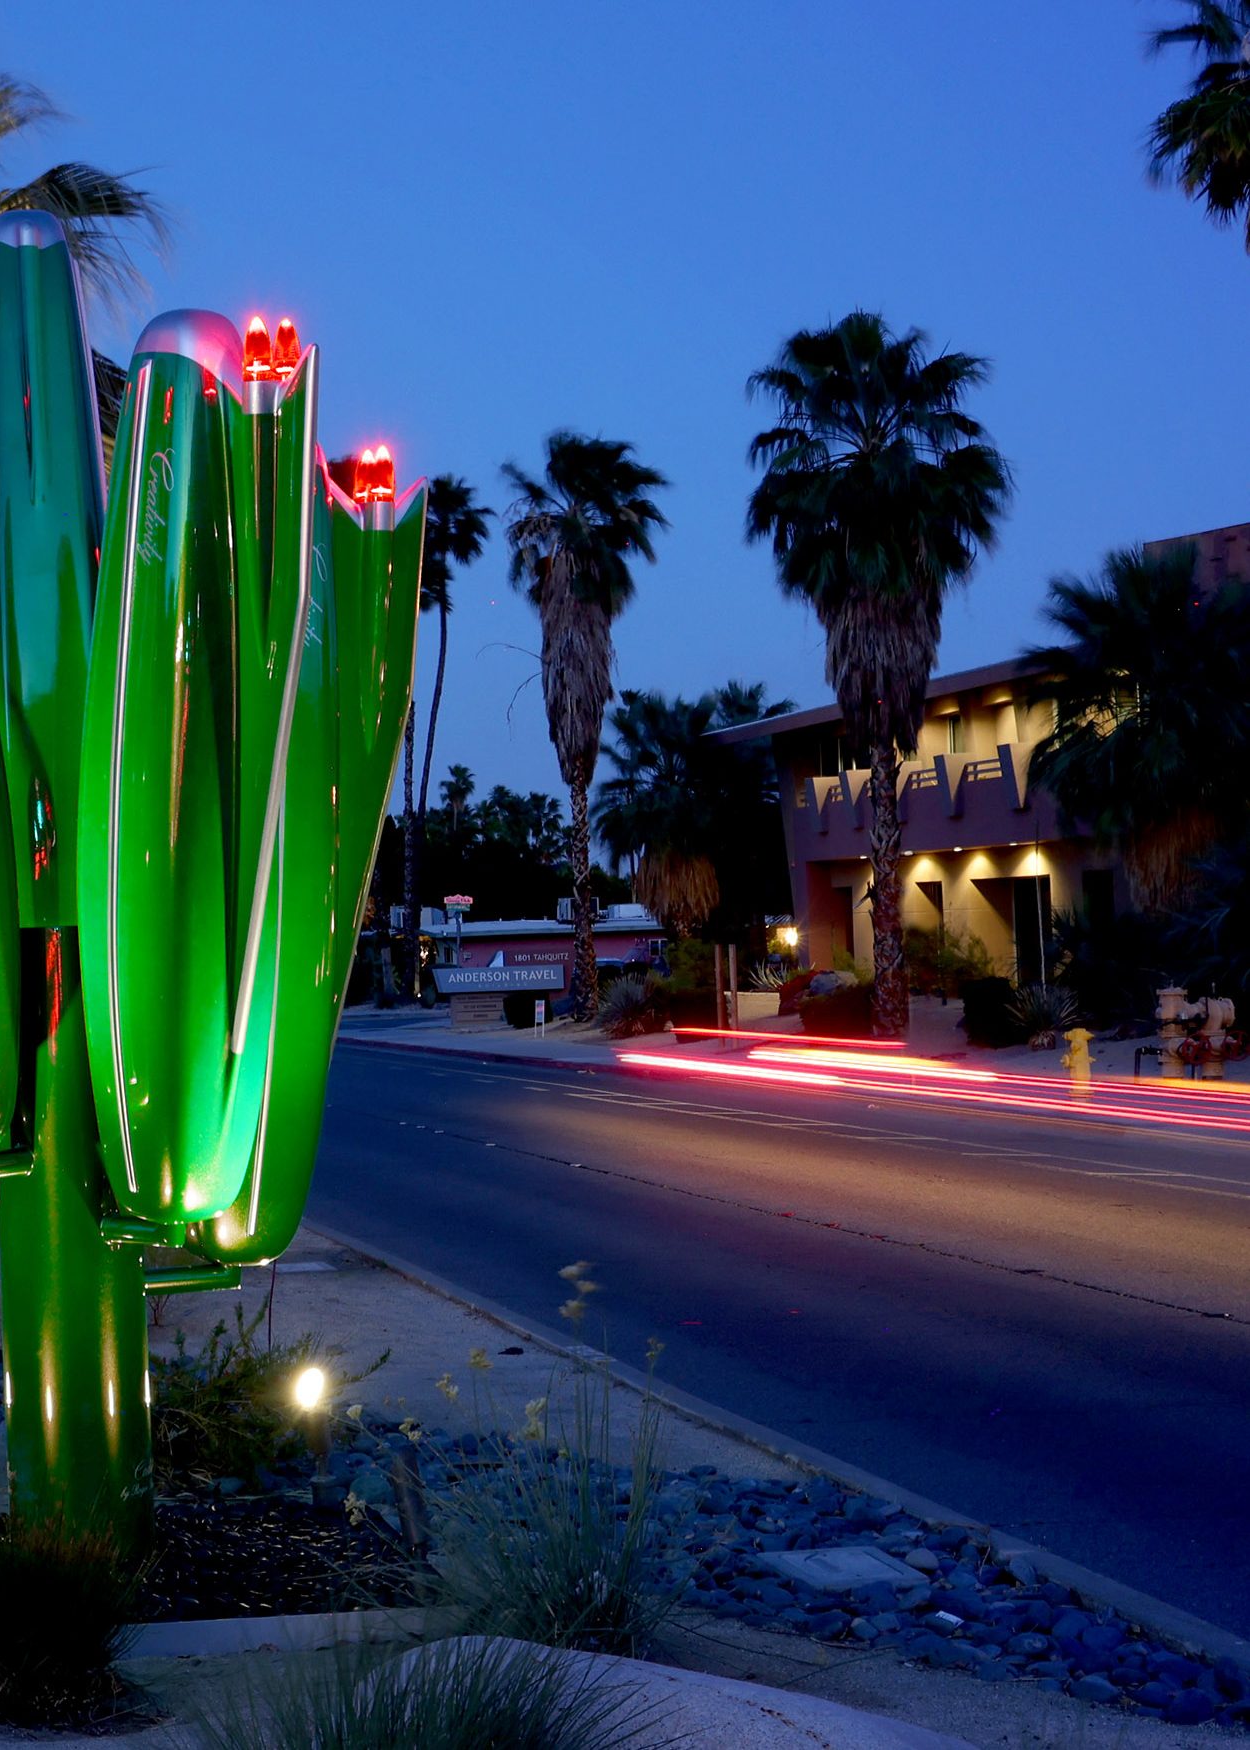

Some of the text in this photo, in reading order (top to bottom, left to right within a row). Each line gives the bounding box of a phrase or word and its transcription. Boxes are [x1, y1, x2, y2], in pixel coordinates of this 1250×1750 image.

[136, 447, 175, 567] Creativity
[514, 952, 570, 962] 1801 TAHQUITZ
[448, 969, 558, 983] ANDERSON TRAVEL
